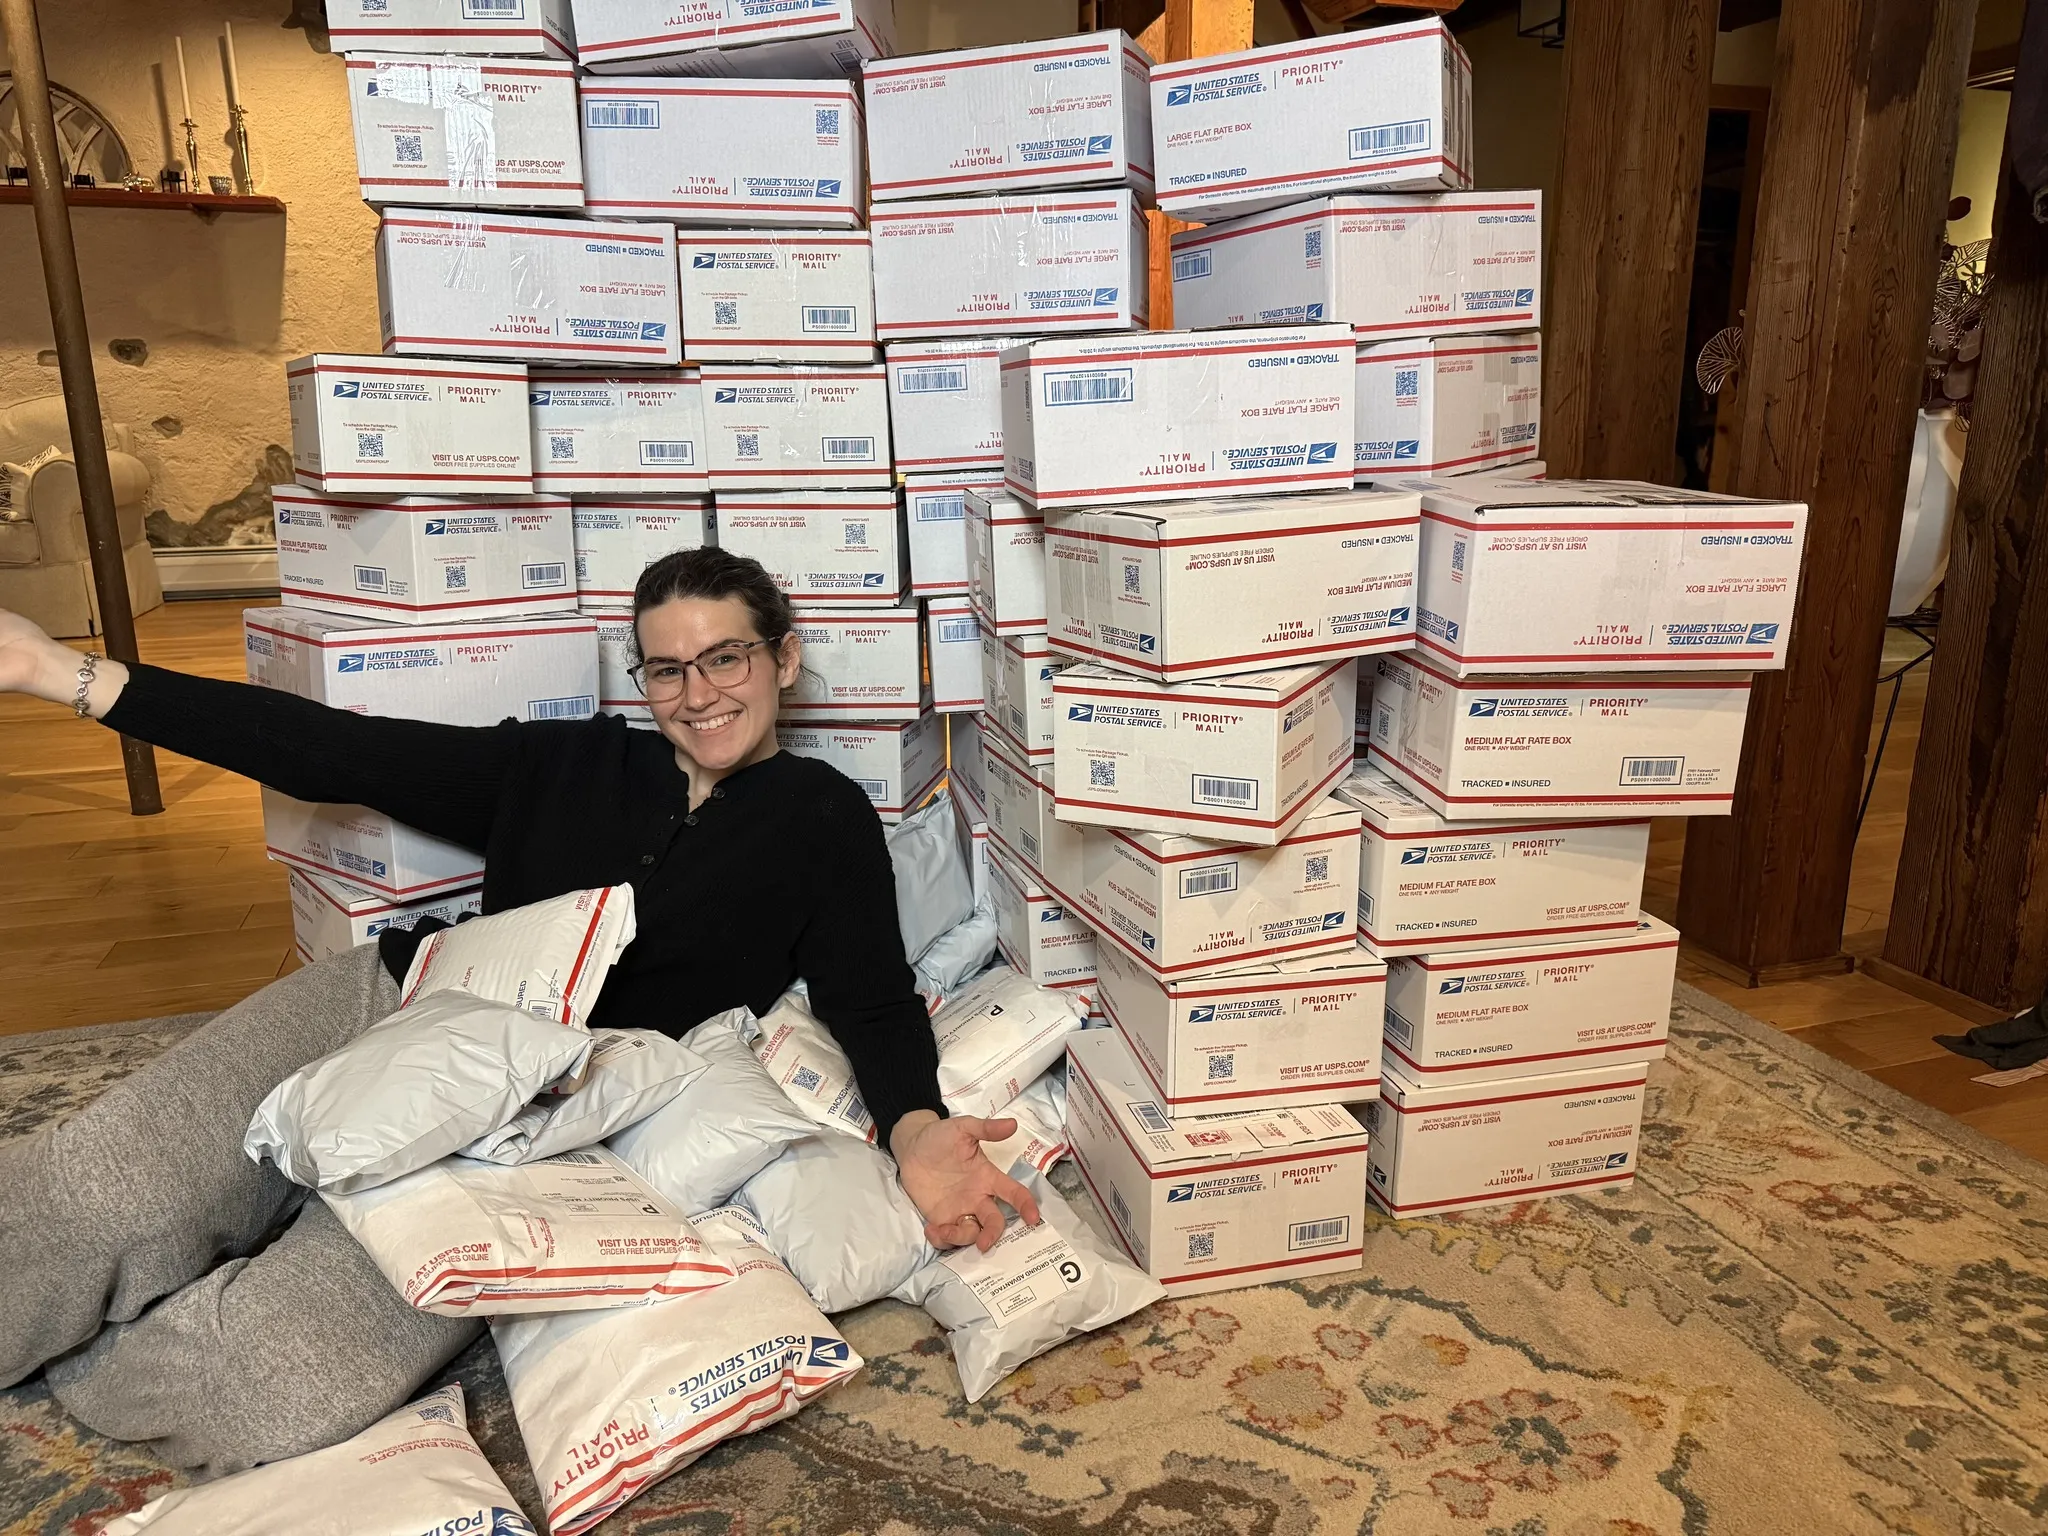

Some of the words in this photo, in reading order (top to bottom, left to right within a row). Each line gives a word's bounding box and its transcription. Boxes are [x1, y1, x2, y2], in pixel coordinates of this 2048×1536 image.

[680, 2, 708, 12] MAIL
[1034, 62, 1068, 72] INSURED
[1074, 57, 1110, 67] TRACKED
[1194, 77, 1228, 91] UNITED
[1227, 73, 1259, 87] STATES
[1296, 74, 1324, 86] MAIL
[498, 94, 525, 102] MAIL
[1193, 90, 1224, 103] POSTAL
[1166, 130, 1192, 142] LARGE
[1194, 128, 1211, 140] FLAT
[1214, 126, 1232, 136] RATE
[1235, 123, 1252, 134] BOX
[965, 148, 990, 156] MAIL
[1170, 173, 1206, 185] TRACKED
[1212, 168, 1247, 180] INSURED
[586, 244, 621, 252] INSURED
[628, 247, 665, 256] TRACKED
[1419, 294, 1440, 302] MAIL
[508, 315, 536, 323] MAIL
[1248, 356, 1288, 368] INSURED
[1297, 354, 1339, 366] TRACKED
[362, 382, 394, 391] UNITED
[395, 383, 425, 391] STATES
[360, 392, 392, 400] POSTAL
[1241, 408, 1260, 417] BOX
[1262, 406, 1285, 416] RATE
[1288, 404, 1308, 414] FLAT
[1310, 402, 1340, 413] LARGE
[1270, 444, 1306, 455] POSTAL
[432, 454, 450, 462] VISIT
[453, 454, 464, 462] US
[466, 454, 475, 462] AT
[1160, 452, 1190, 462] MAIL
[1266, 456, 1304, 468] UNITED
[1230, 458, 1266, 470] STATES
[1701, 535, 1742, 546] INSURED
[1751, 535, 1793, 546] TRACKED
[1278, 621, 1303, 630] MAIL
[1597, 625, 1628, 633] MAIL
[368, 651, 400, 661] UNITED
[402, 649, 435, 658] STATES
[470, 654, 498, 662] MAIL
[367, 661, 400, 670] POSTAL
[1500, 698, 1535, 707] UNITED
[1535, 698, 1568, 707] STATES
[1497, 708, 1530, 717] POSTAL
[1196, 725, 1224, 733] MAIL
[1465, 737, 1502, 745] MEDIUM
[1461, 779, 1503, 788] TRACKED
[1511, 779, 1551, 788] INSURED
[1523, 848, 1549, 857] MAIL
[1399, 882, 1433, 891] MEDIUM
[1456, 879, 1477, 887] RATE
[1478, 878, 1496, 886] BOX
[1396, 921, 1434, 931] TRACKED
[1442, 919, 1477, 928] INSURED
[1044, 968, 1077, 977] TRACKED
[1554, 974, 1578, 983] MAIL
[1218, 1001, 1248, 1011] UNITED
[1250, 999, 1280, 1008] STATES
[1314, 1003, 1340, 1012] MAIL
[1215, 1011, 1246, 1020] POSTAL
[1280, 1066, 1300, 1074] VISIT
[1302, 1064, 1313, 1073] US
[1314, 1064, 1323, 1072] AT
[1564, 1098, 1596, 1108] INSURED
[1603, 1094, 1636, 1104] TRACKED
[1500, 1168, 1523, 1176] MAIL
[1294, 1176, 1321, 1185] MAIL
[598, 1239, 622, 1248] VISIT
[624, 1238, 638, 1247] US
[640, 1238, 651, 1246] AT
[645, 1246, 677, 1254] SUPPLIES
[1050, 1253, 1066, 1264] USPS
[1025, 1262, 1050, 1276] GROUND
[1059, 1261, 1082, 1283] G
[990, 1272, 1024, 1297] ADVANTAGE
[747, 1335, 806, 1359] POSTAL
[749, 1350, 802, 1384] UNITED
[691, 1374, 746, 1413] STATES
[567, 1420, 619, 1458] MAIL
[368, 1442, 438, 1465] ENVELOPE
